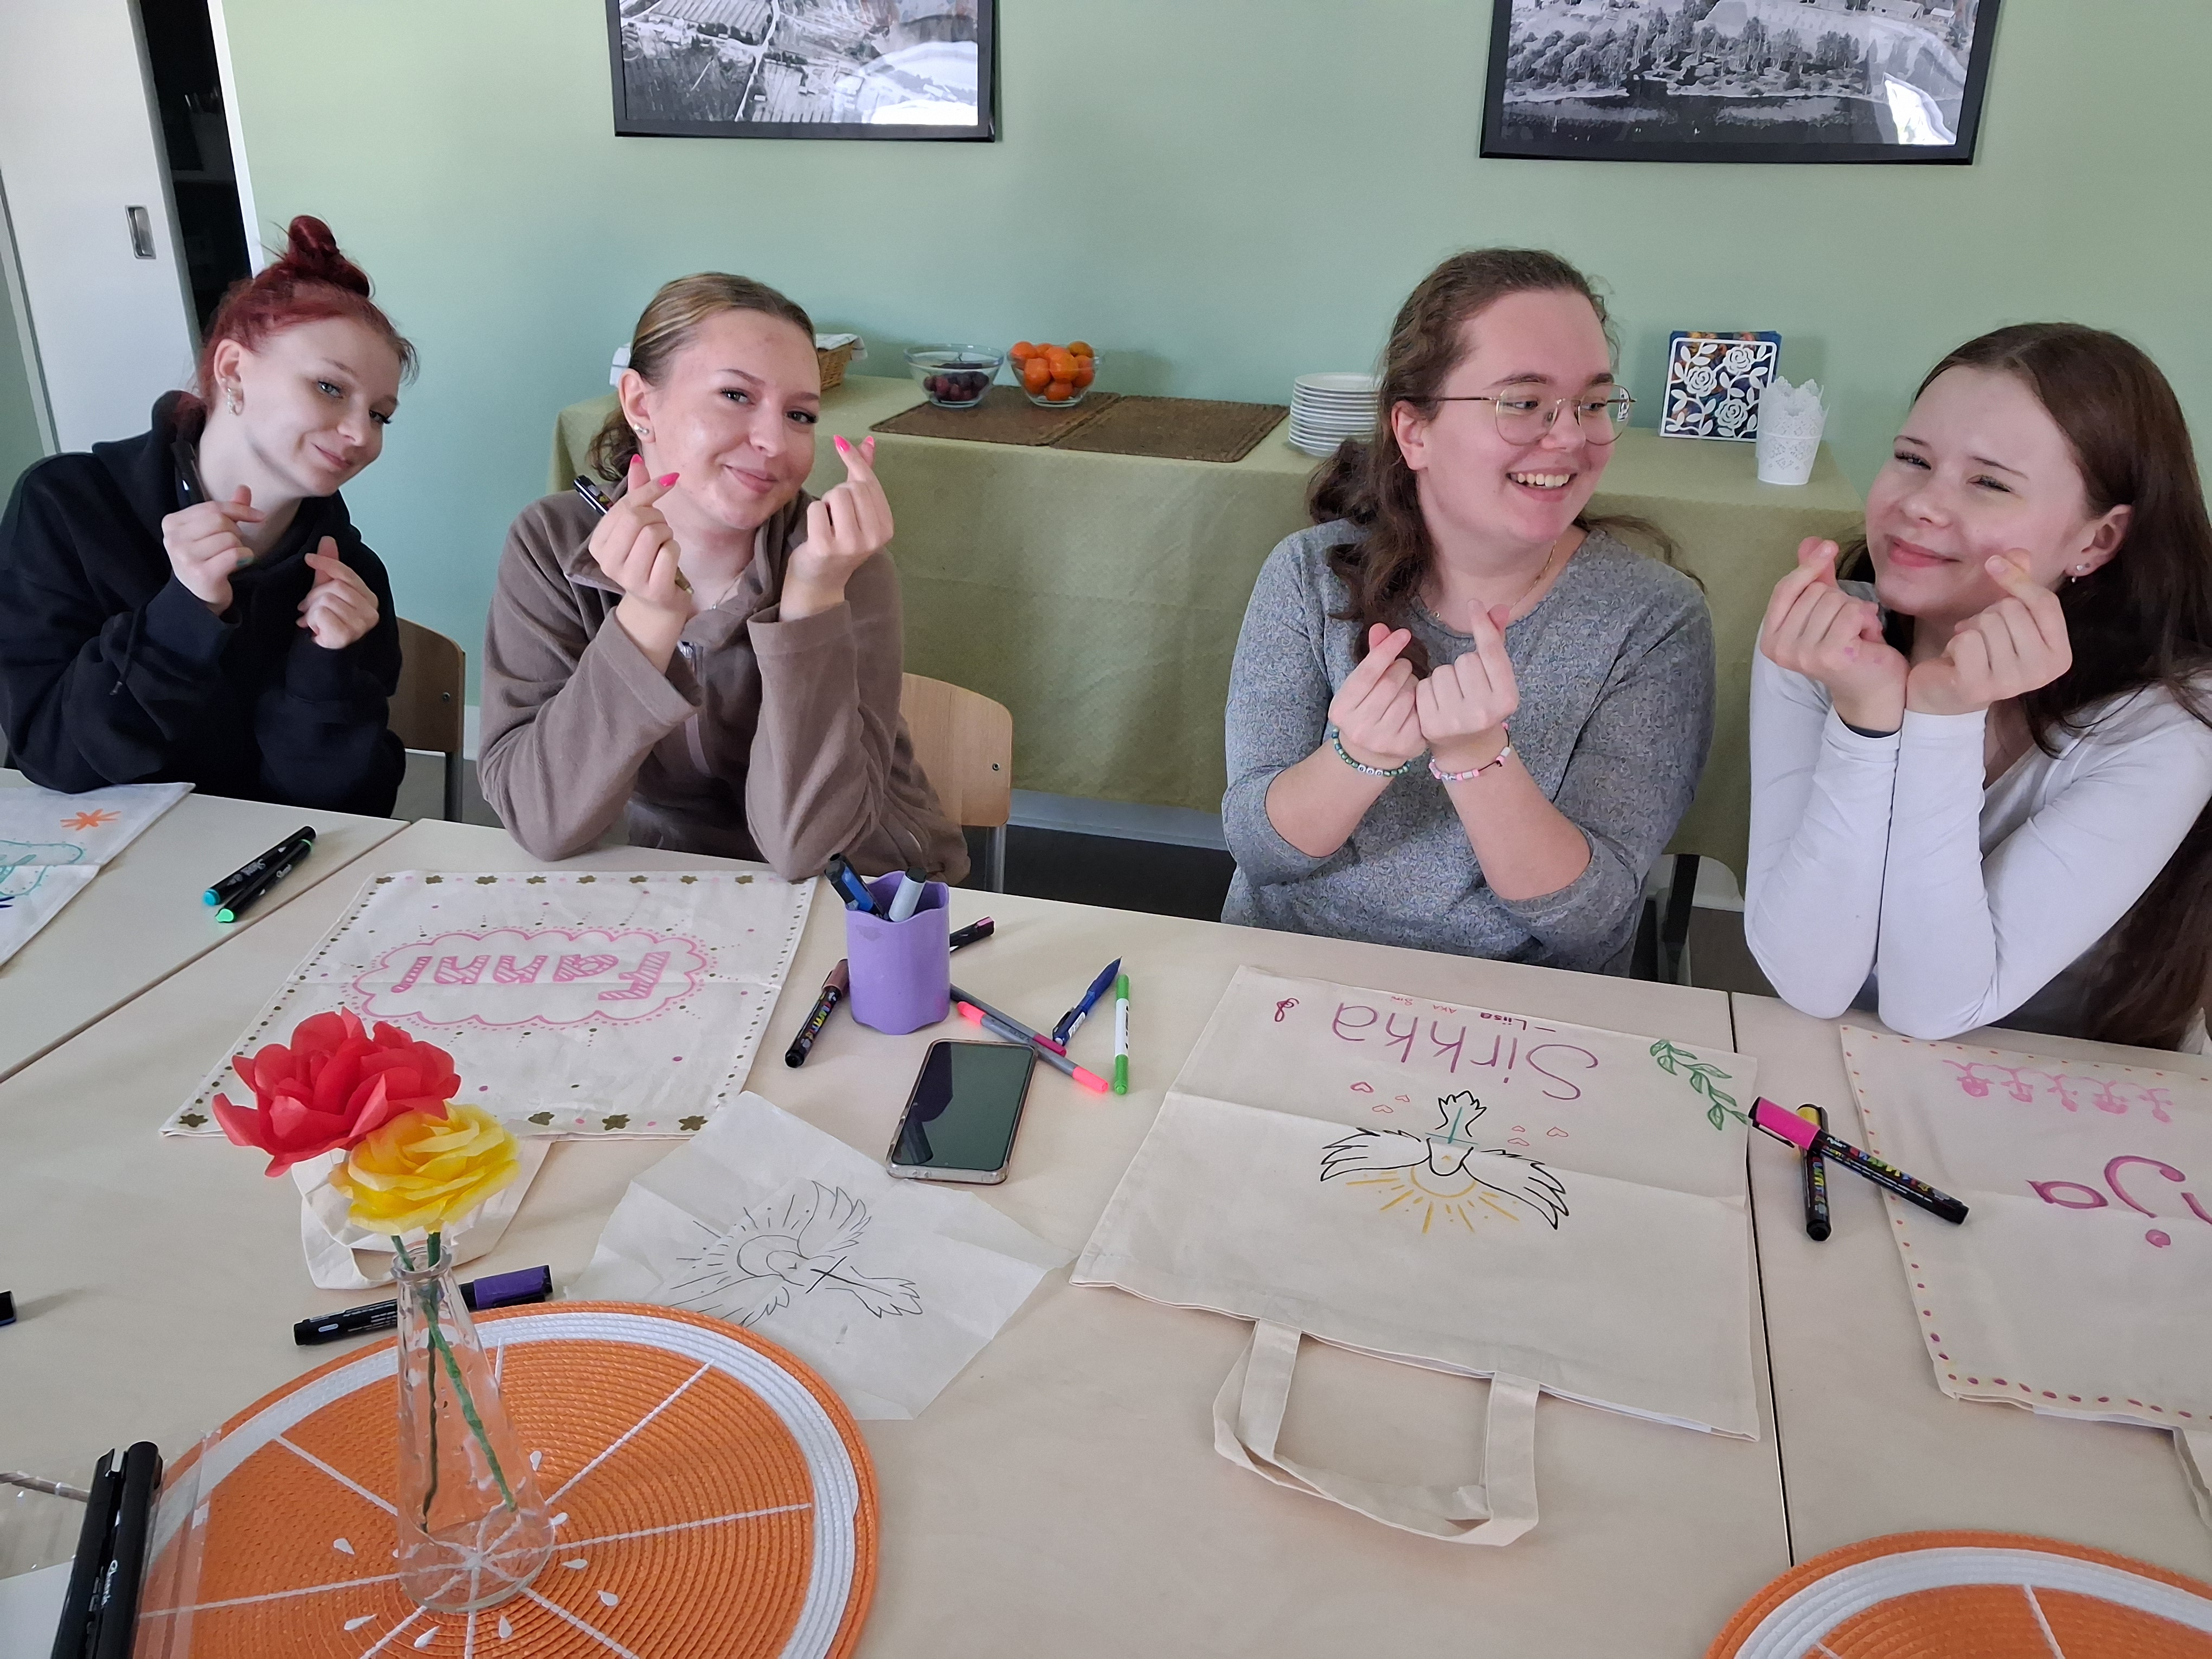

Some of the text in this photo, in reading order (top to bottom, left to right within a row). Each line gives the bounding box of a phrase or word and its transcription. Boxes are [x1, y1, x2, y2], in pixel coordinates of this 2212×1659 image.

[390, 951, 671, 1001] Fanni
[1432, 1005, 1457, 1014] AKA
[1332, 1002, 1599, 1101] Sirkka
